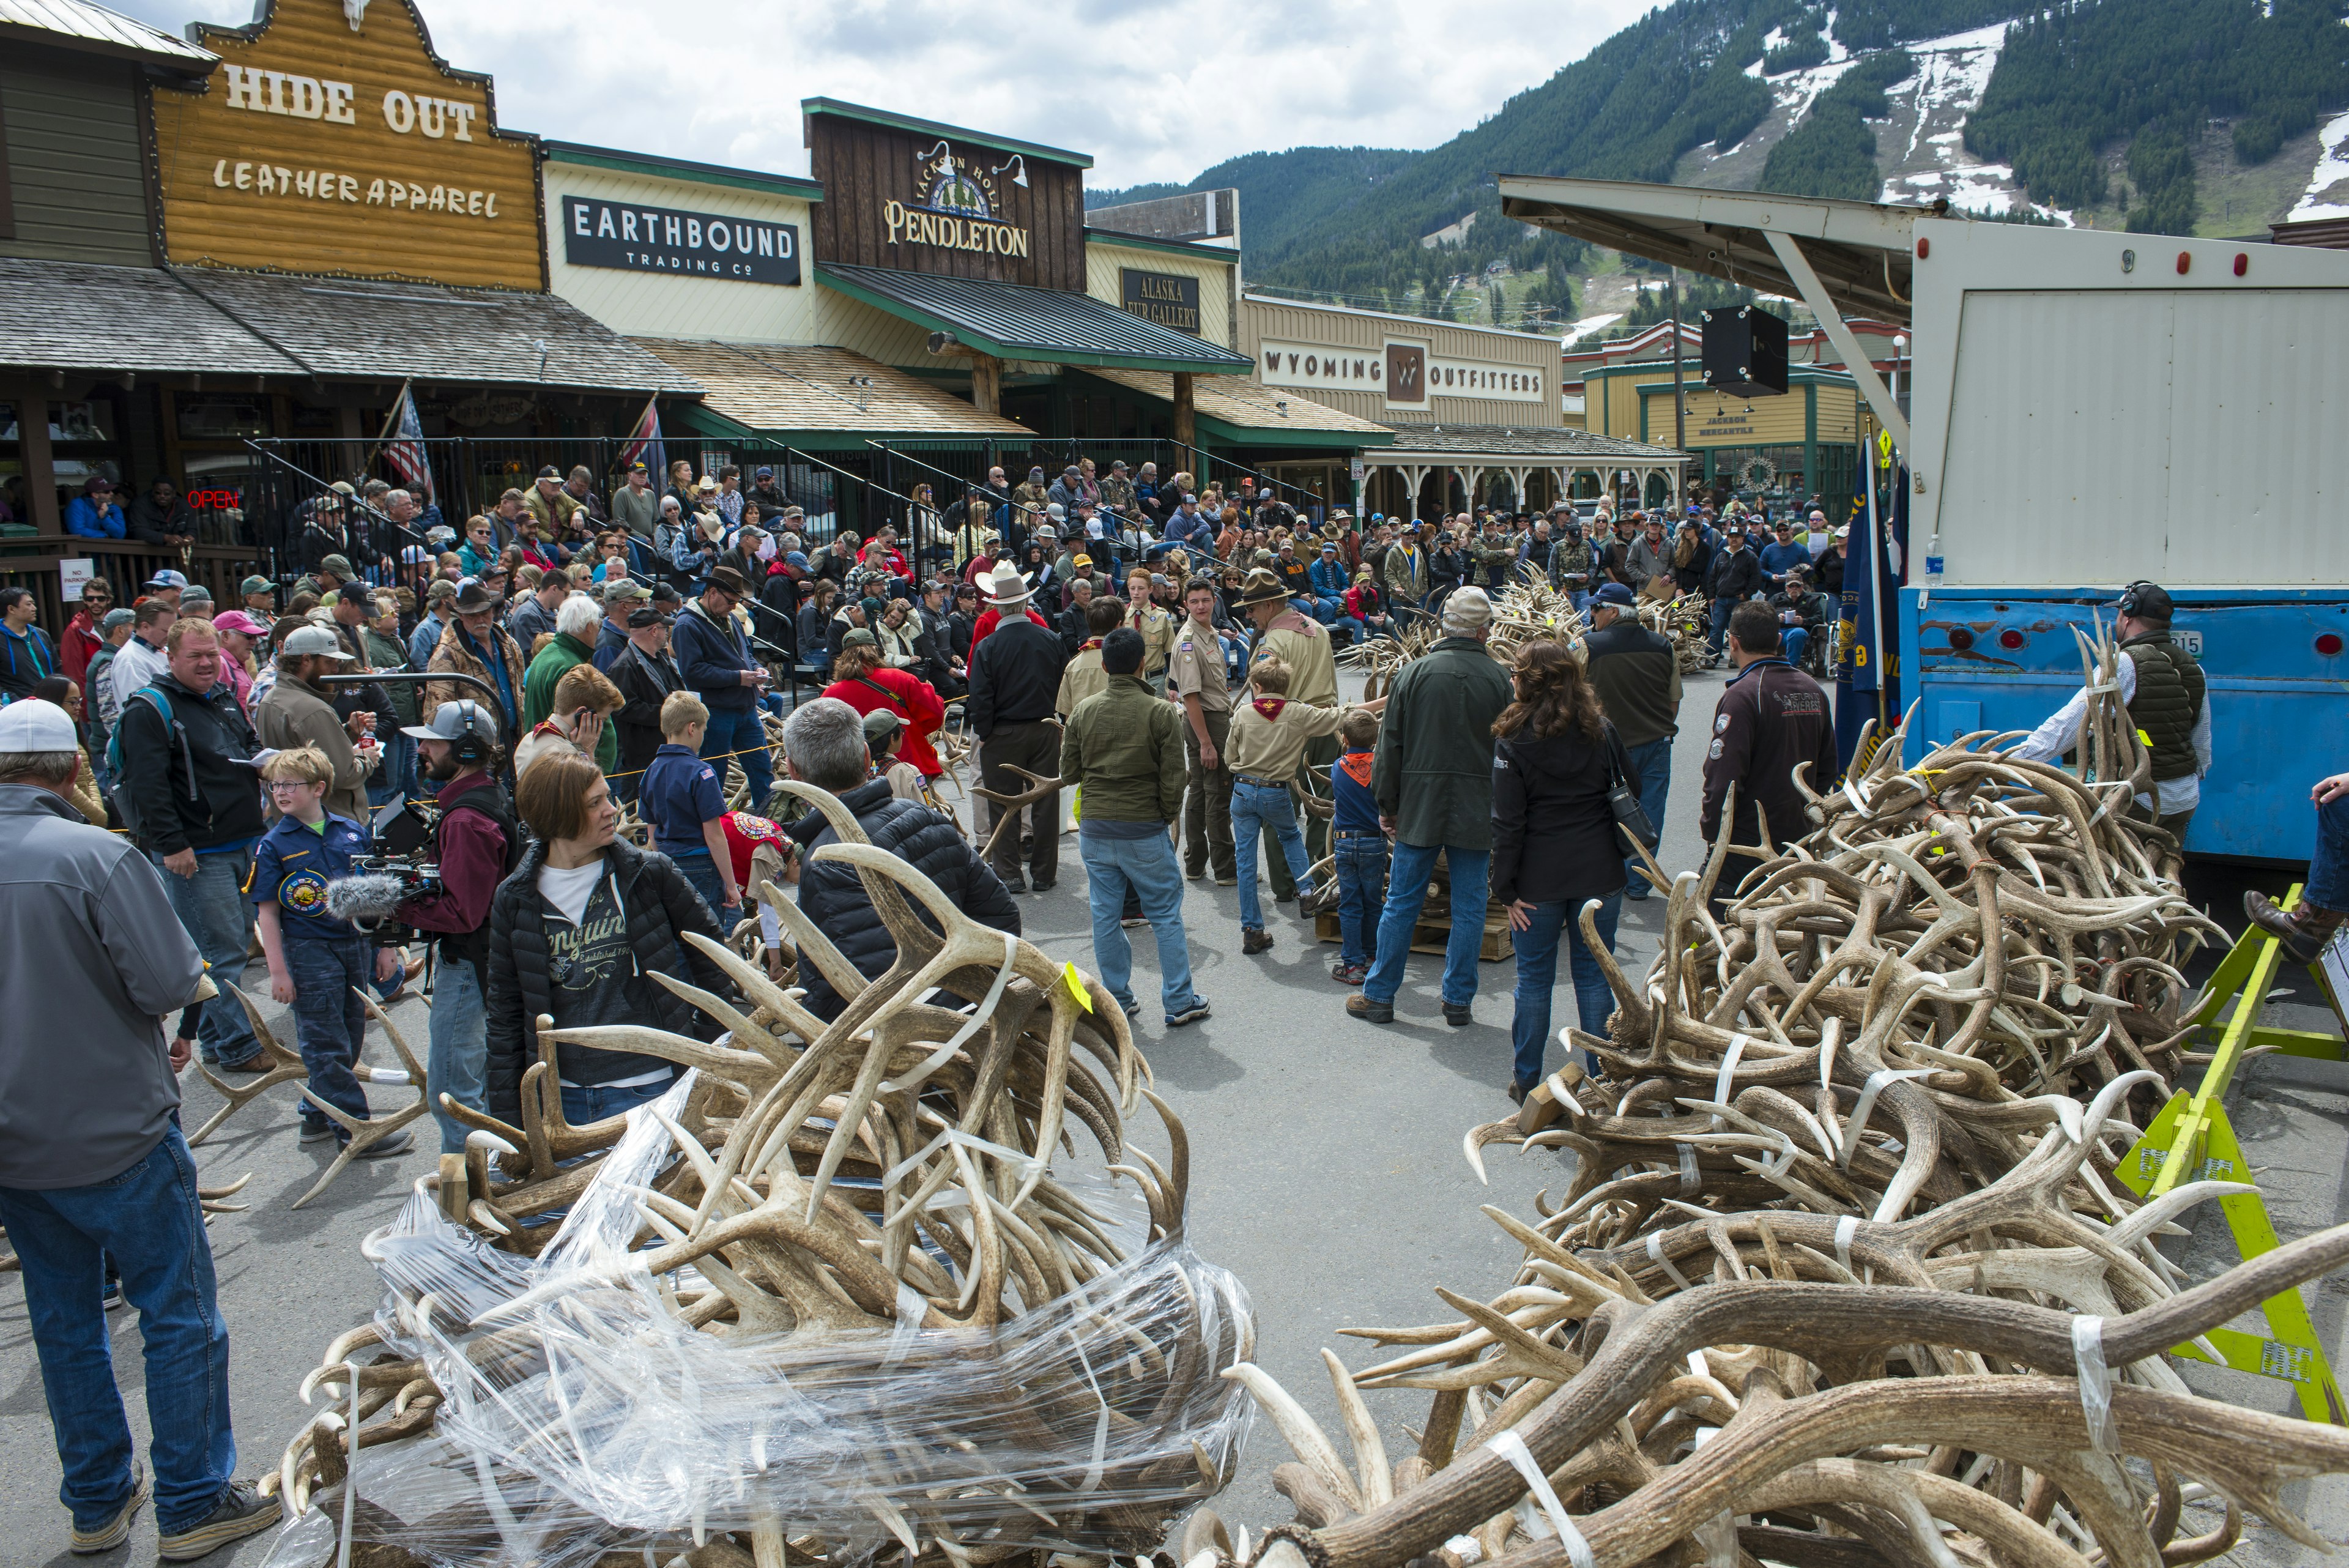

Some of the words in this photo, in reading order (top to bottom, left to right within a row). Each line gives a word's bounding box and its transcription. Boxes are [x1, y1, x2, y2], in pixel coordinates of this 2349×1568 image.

[223, 64, 355, 125] HIDE
[382, 90, 475, 142] OUT
[213, 160, 359, 202] LEATHER
[366, 178, 499, 218] APPAREL
[973, 166, 1000, 212] HOLE
[573, 204, 792, 259] EARTHBOUND
[884, 199, 1028, 258] PENDLETON
[626, 252, 720, 273] TRADING
[1140, 277, 1184, 302] ALASKA
[1151, 303, 1197, 329] GALLERY
[1266, 351, 1381, 381] WYOMING
[1430, 366, 1539, 393] OUTFITTERS
[1699, 427, 1753, 436] MERCANTILE
[188, 491, 239, 509] OPEN
[2171, 637, 2199, 653] 15
[1789, 693, 1812, 701] RETURN
[1791, 700, 1821, 712] EVEREST
[579, 949, 617, 964] Established
[617, 946, 632, 956] 196
